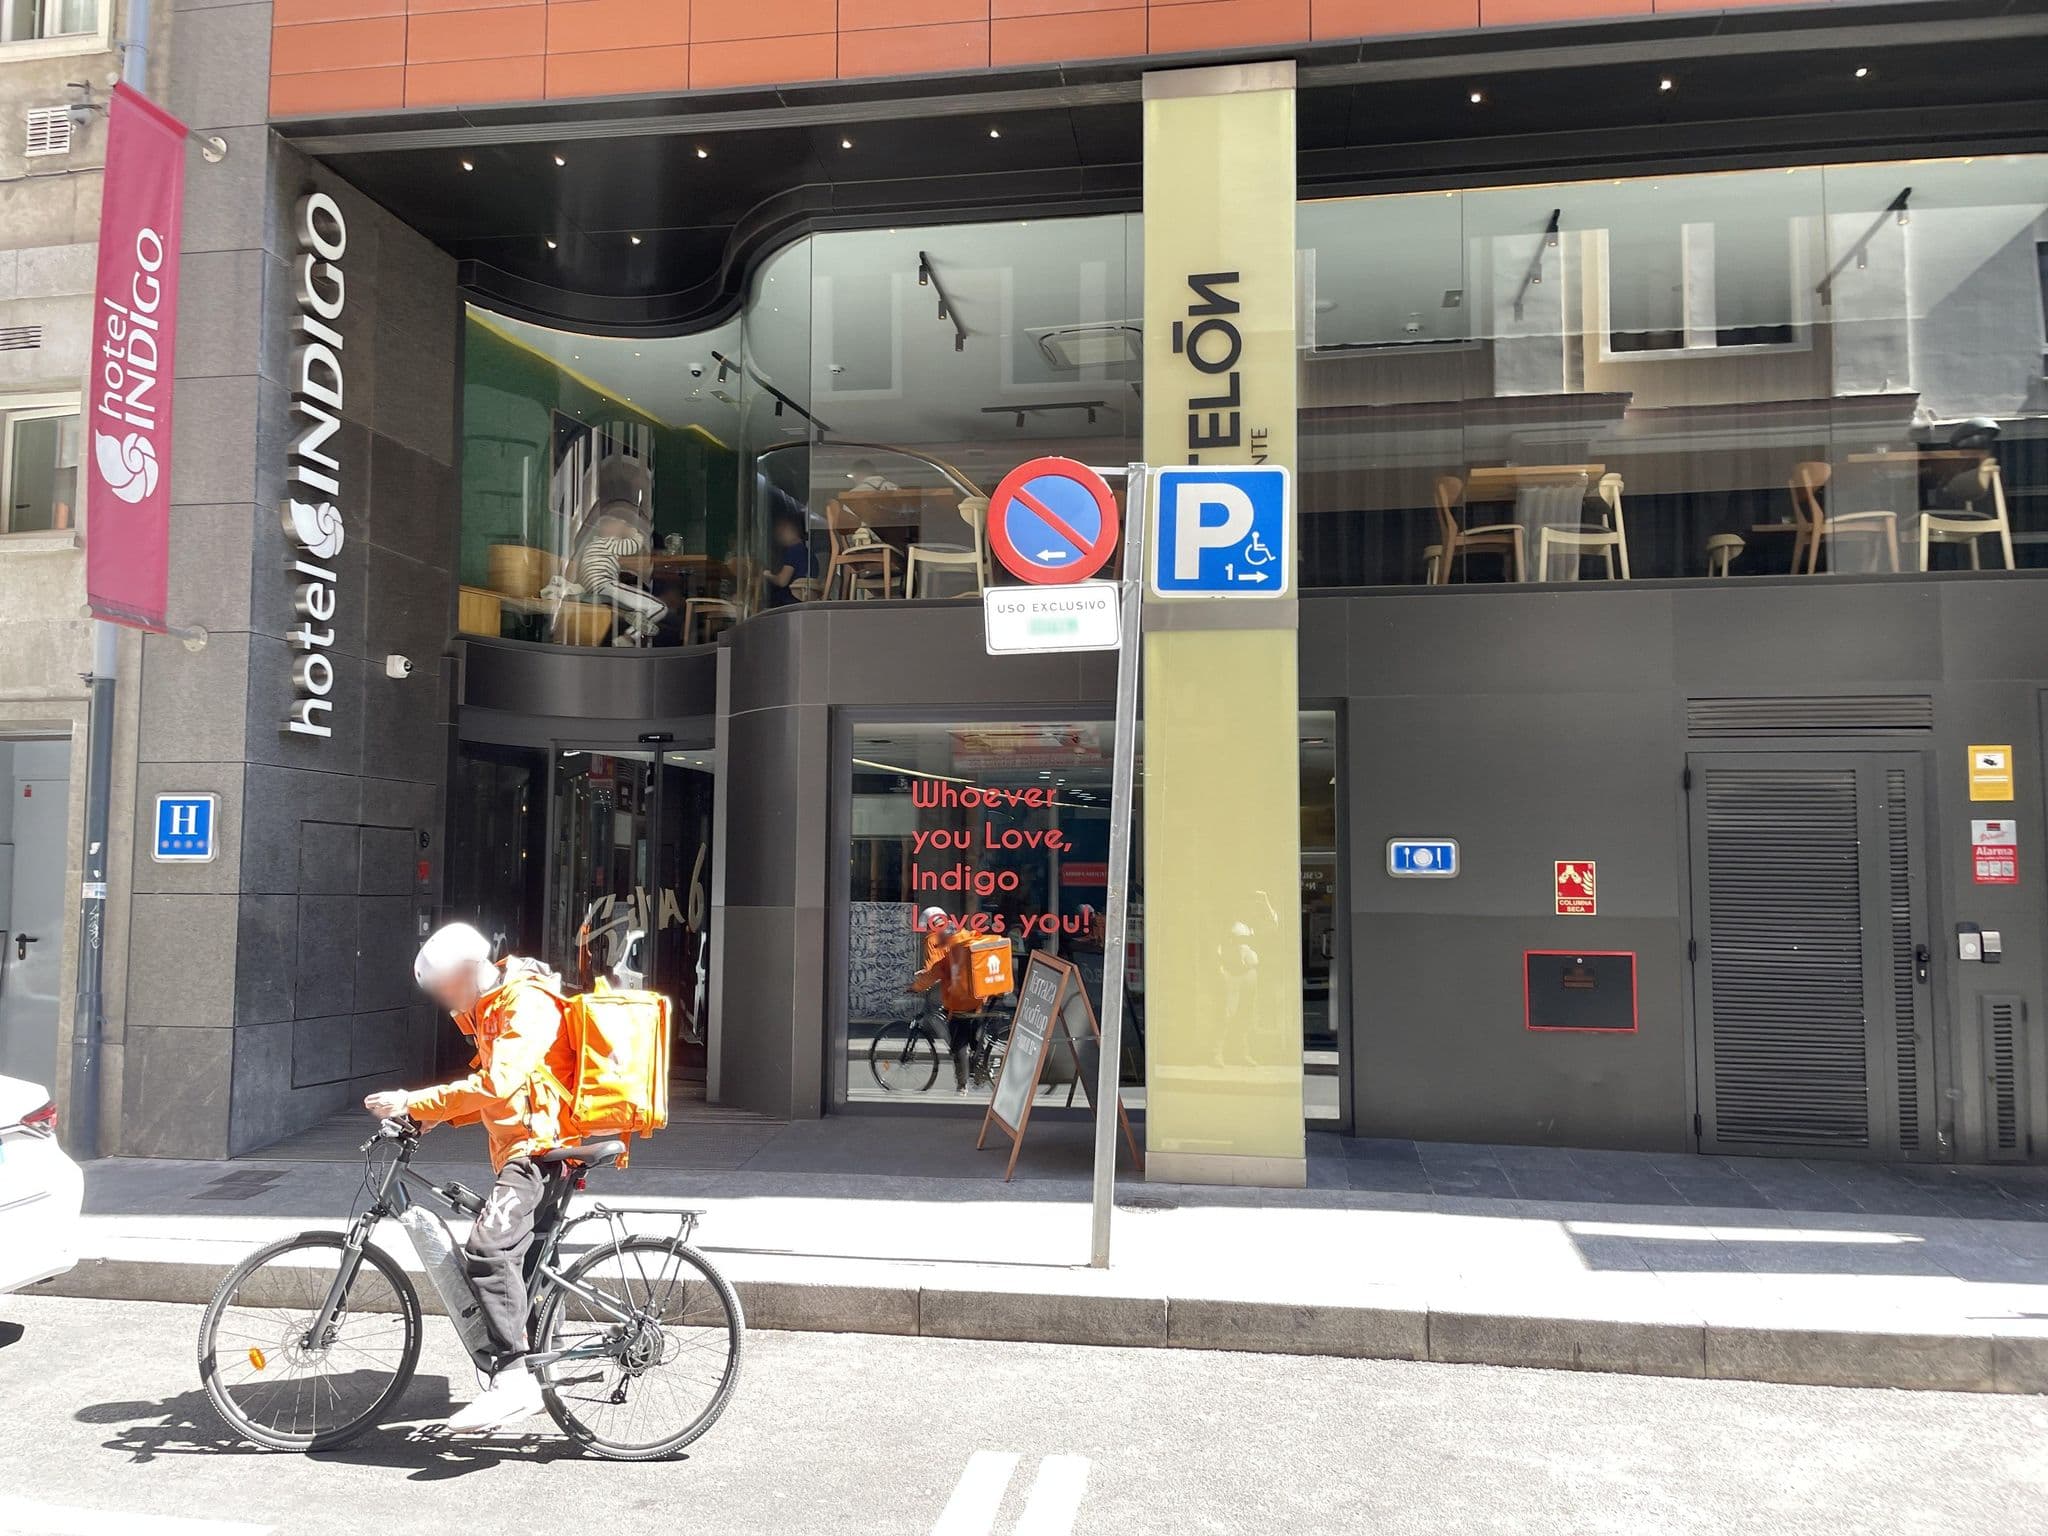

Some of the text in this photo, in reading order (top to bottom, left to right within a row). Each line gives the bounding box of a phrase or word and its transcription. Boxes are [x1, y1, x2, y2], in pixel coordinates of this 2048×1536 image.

[125, 228, 163, 430] INDIGO
[99, 297, 128, 420] hotel
[289, 192, 346, 738] hotel INDIGO
[1174, 482, 1255, 580] P
[1225, 564, 1234, 581] 1
[997, 600, 1106, 614] USO EXCLUSIVO
[912, 781, 1057, 808] Whoever
[168, 805, 200, 836] H
[912, 822, 1072, 854] you Love,
[1976, 846, 2014, 856] Alarma
[912, 863, 1019, 896] Indigo
[912, 905, 1090, 939] Loves you!
